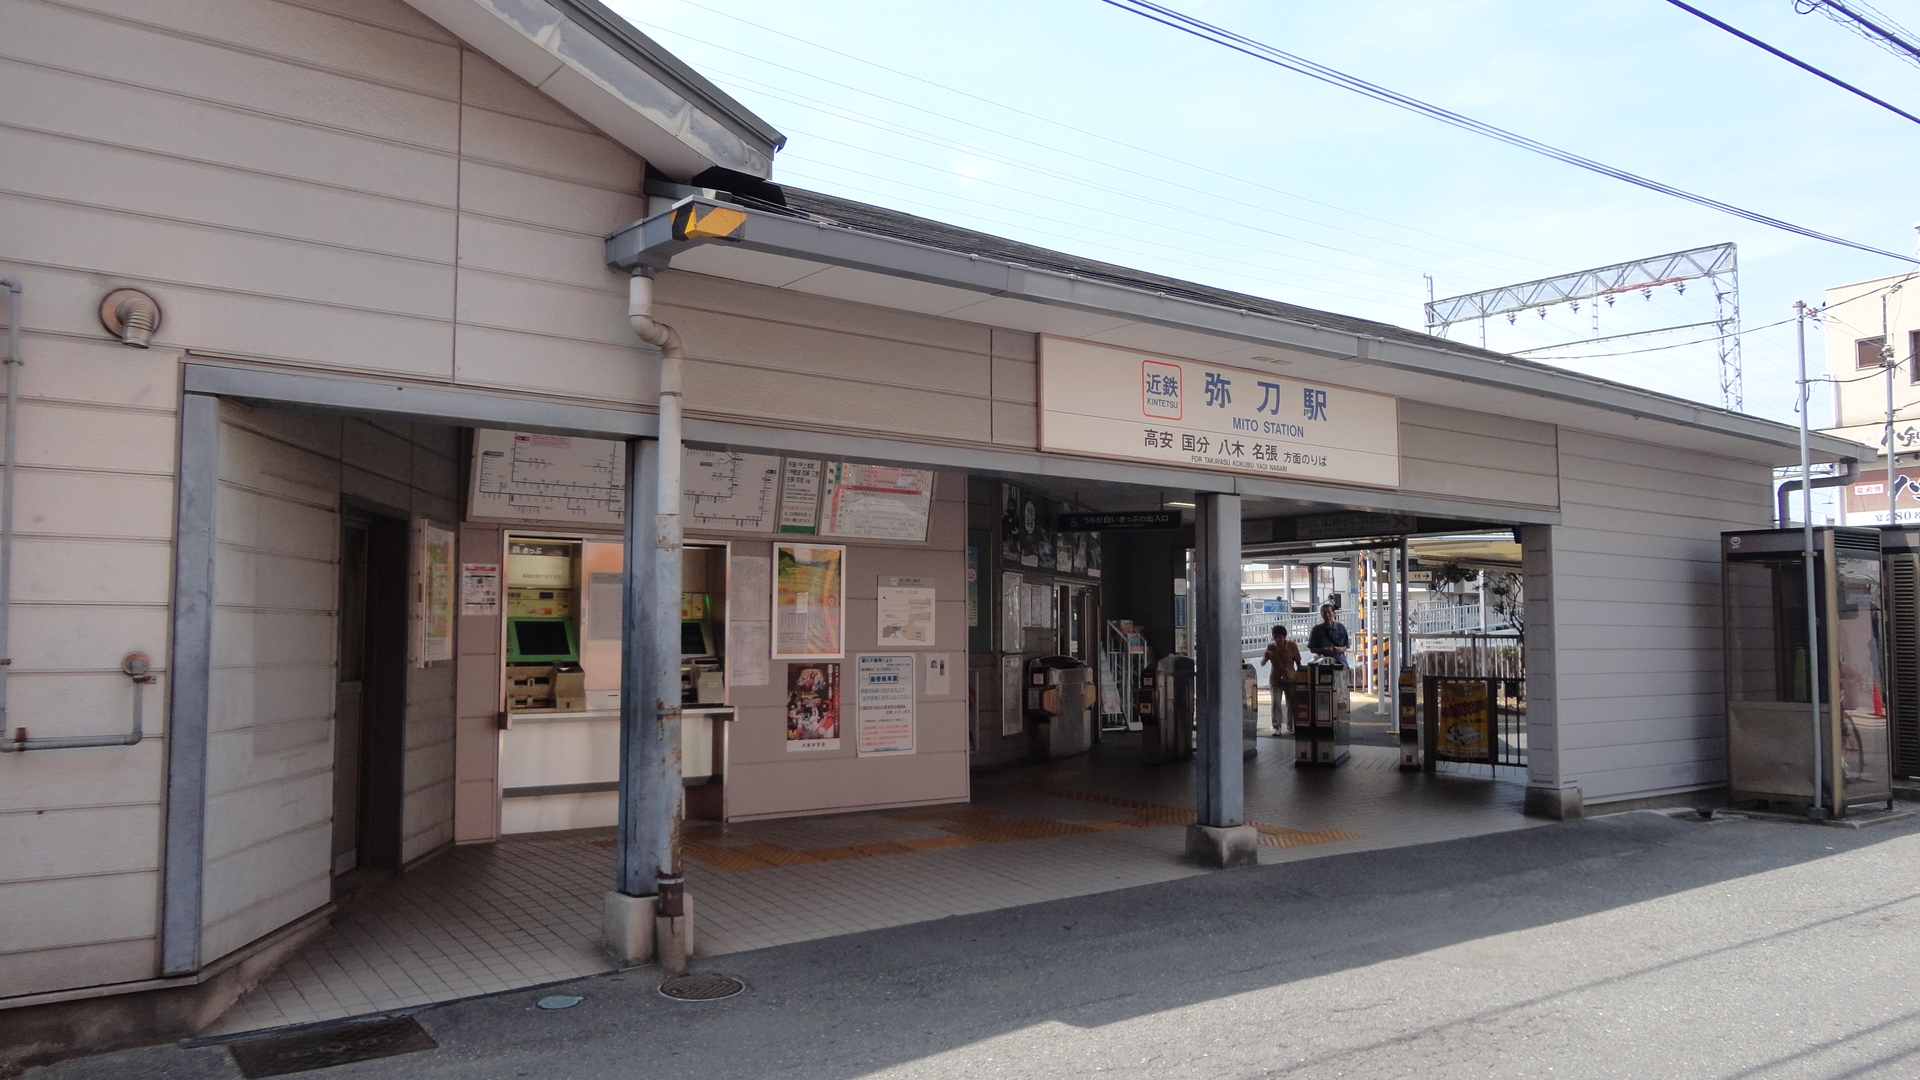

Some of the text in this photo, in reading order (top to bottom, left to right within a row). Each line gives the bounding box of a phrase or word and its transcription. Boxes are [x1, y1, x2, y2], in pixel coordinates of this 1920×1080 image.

[1146, 373, 1178, 398] 近鉄
[1146, 397, 1178, 409] KINTETSU
[1232, 416, 1304, 438] MITO STATION
[1144, 429, 1328, 467] 高安 国分 八木 名張 方面のりば
[1191, 455, 1203, 463] FOR
[1204, 456, 1231, 466] TAKAYASU
[1232, 460, 1255, 469] KOKUBU
[1270, 464, 1288, 472] NABARI
[522, 547, 543, 555] きっぷ
